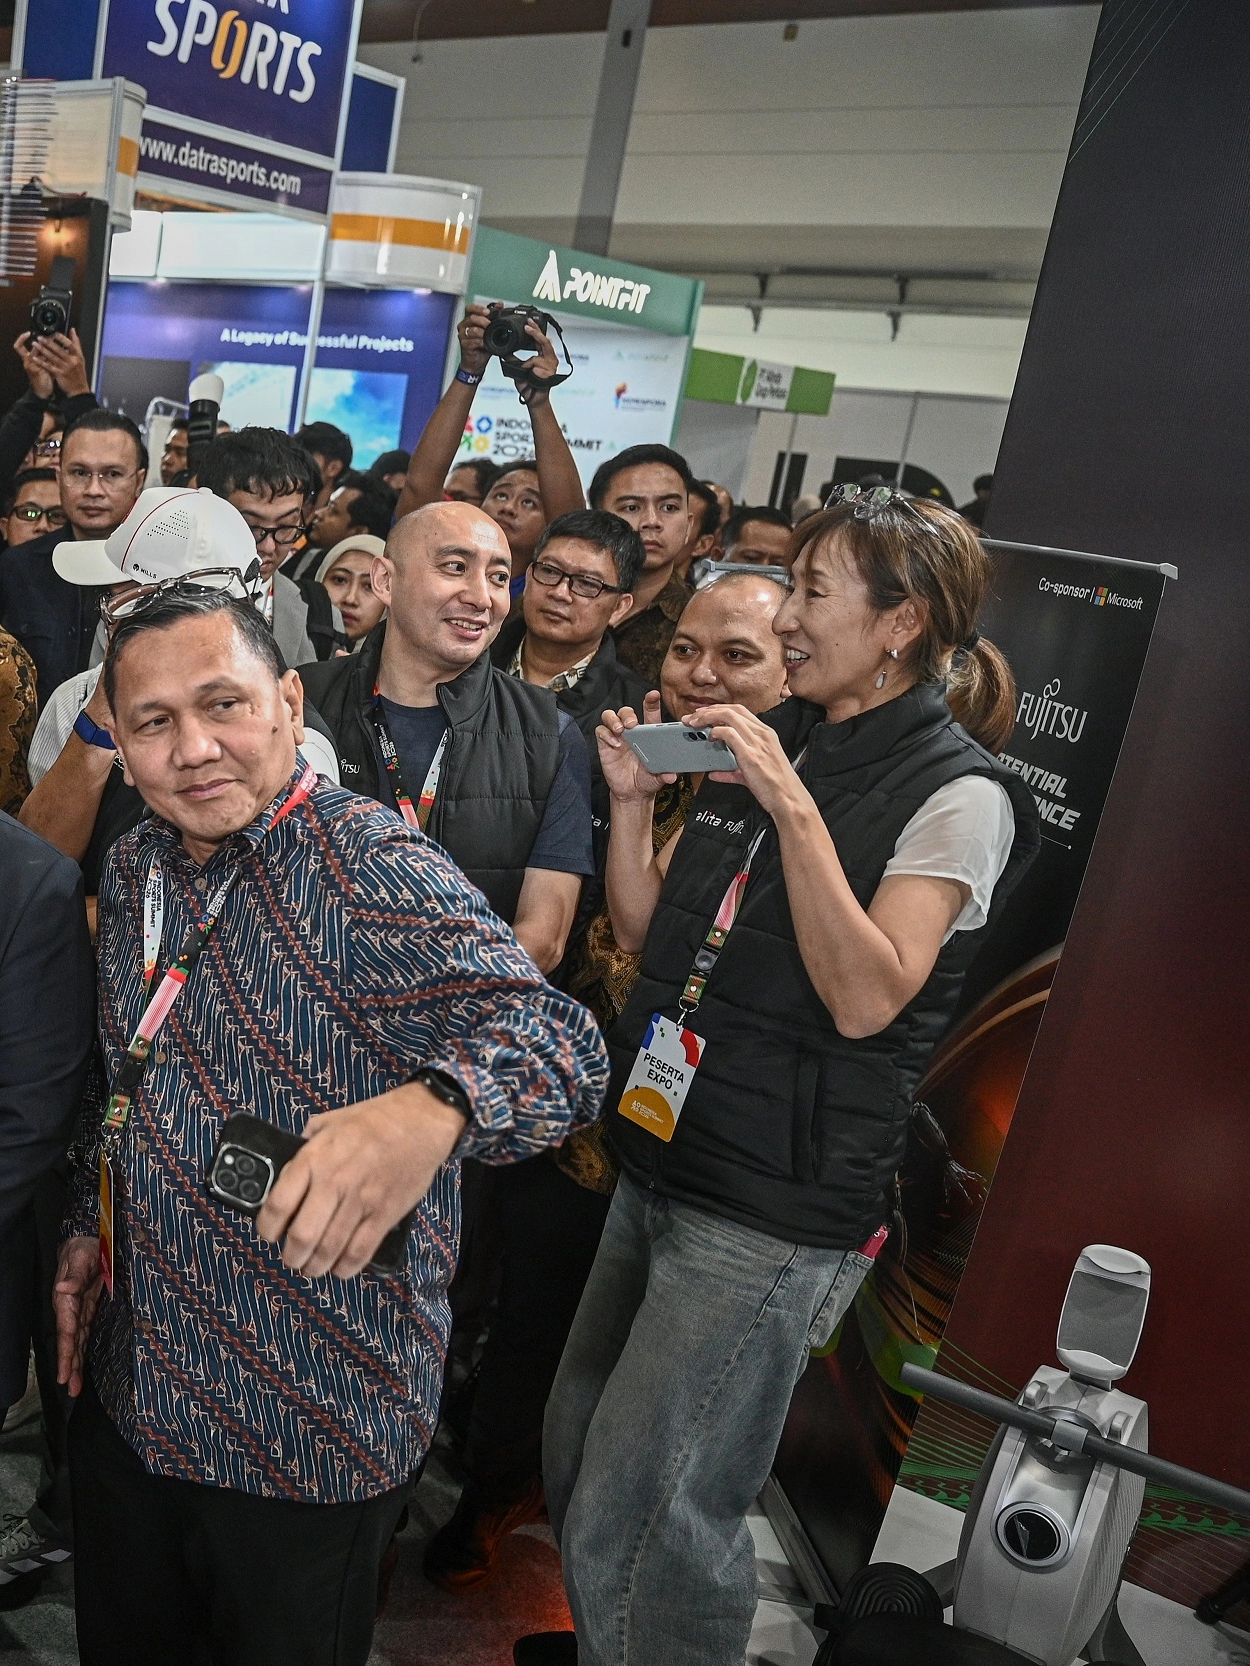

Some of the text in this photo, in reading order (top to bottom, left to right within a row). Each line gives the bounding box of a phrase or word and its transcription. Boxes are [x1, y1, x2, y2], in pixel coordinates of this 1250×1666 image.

[147, 0, 323, 103] SPORTS
[139, 136, 301, 195] www.datrasports.com
[220, 328, 415, 353] A Legacy of Suessful Projects
[1038, 577, 1144, 610] Co-sponsor Microsoft
[1015, 680, 1088, 743] FUJITSU
[340, 758, 361, 774] ITSU
[996, 752, 1068, 799] TENTIAL
[1033, 794, 1081, 831] NCE
[643, 1052, 685, 1084] PESERTA
[647, 1068, 673, 1090] EXPO
